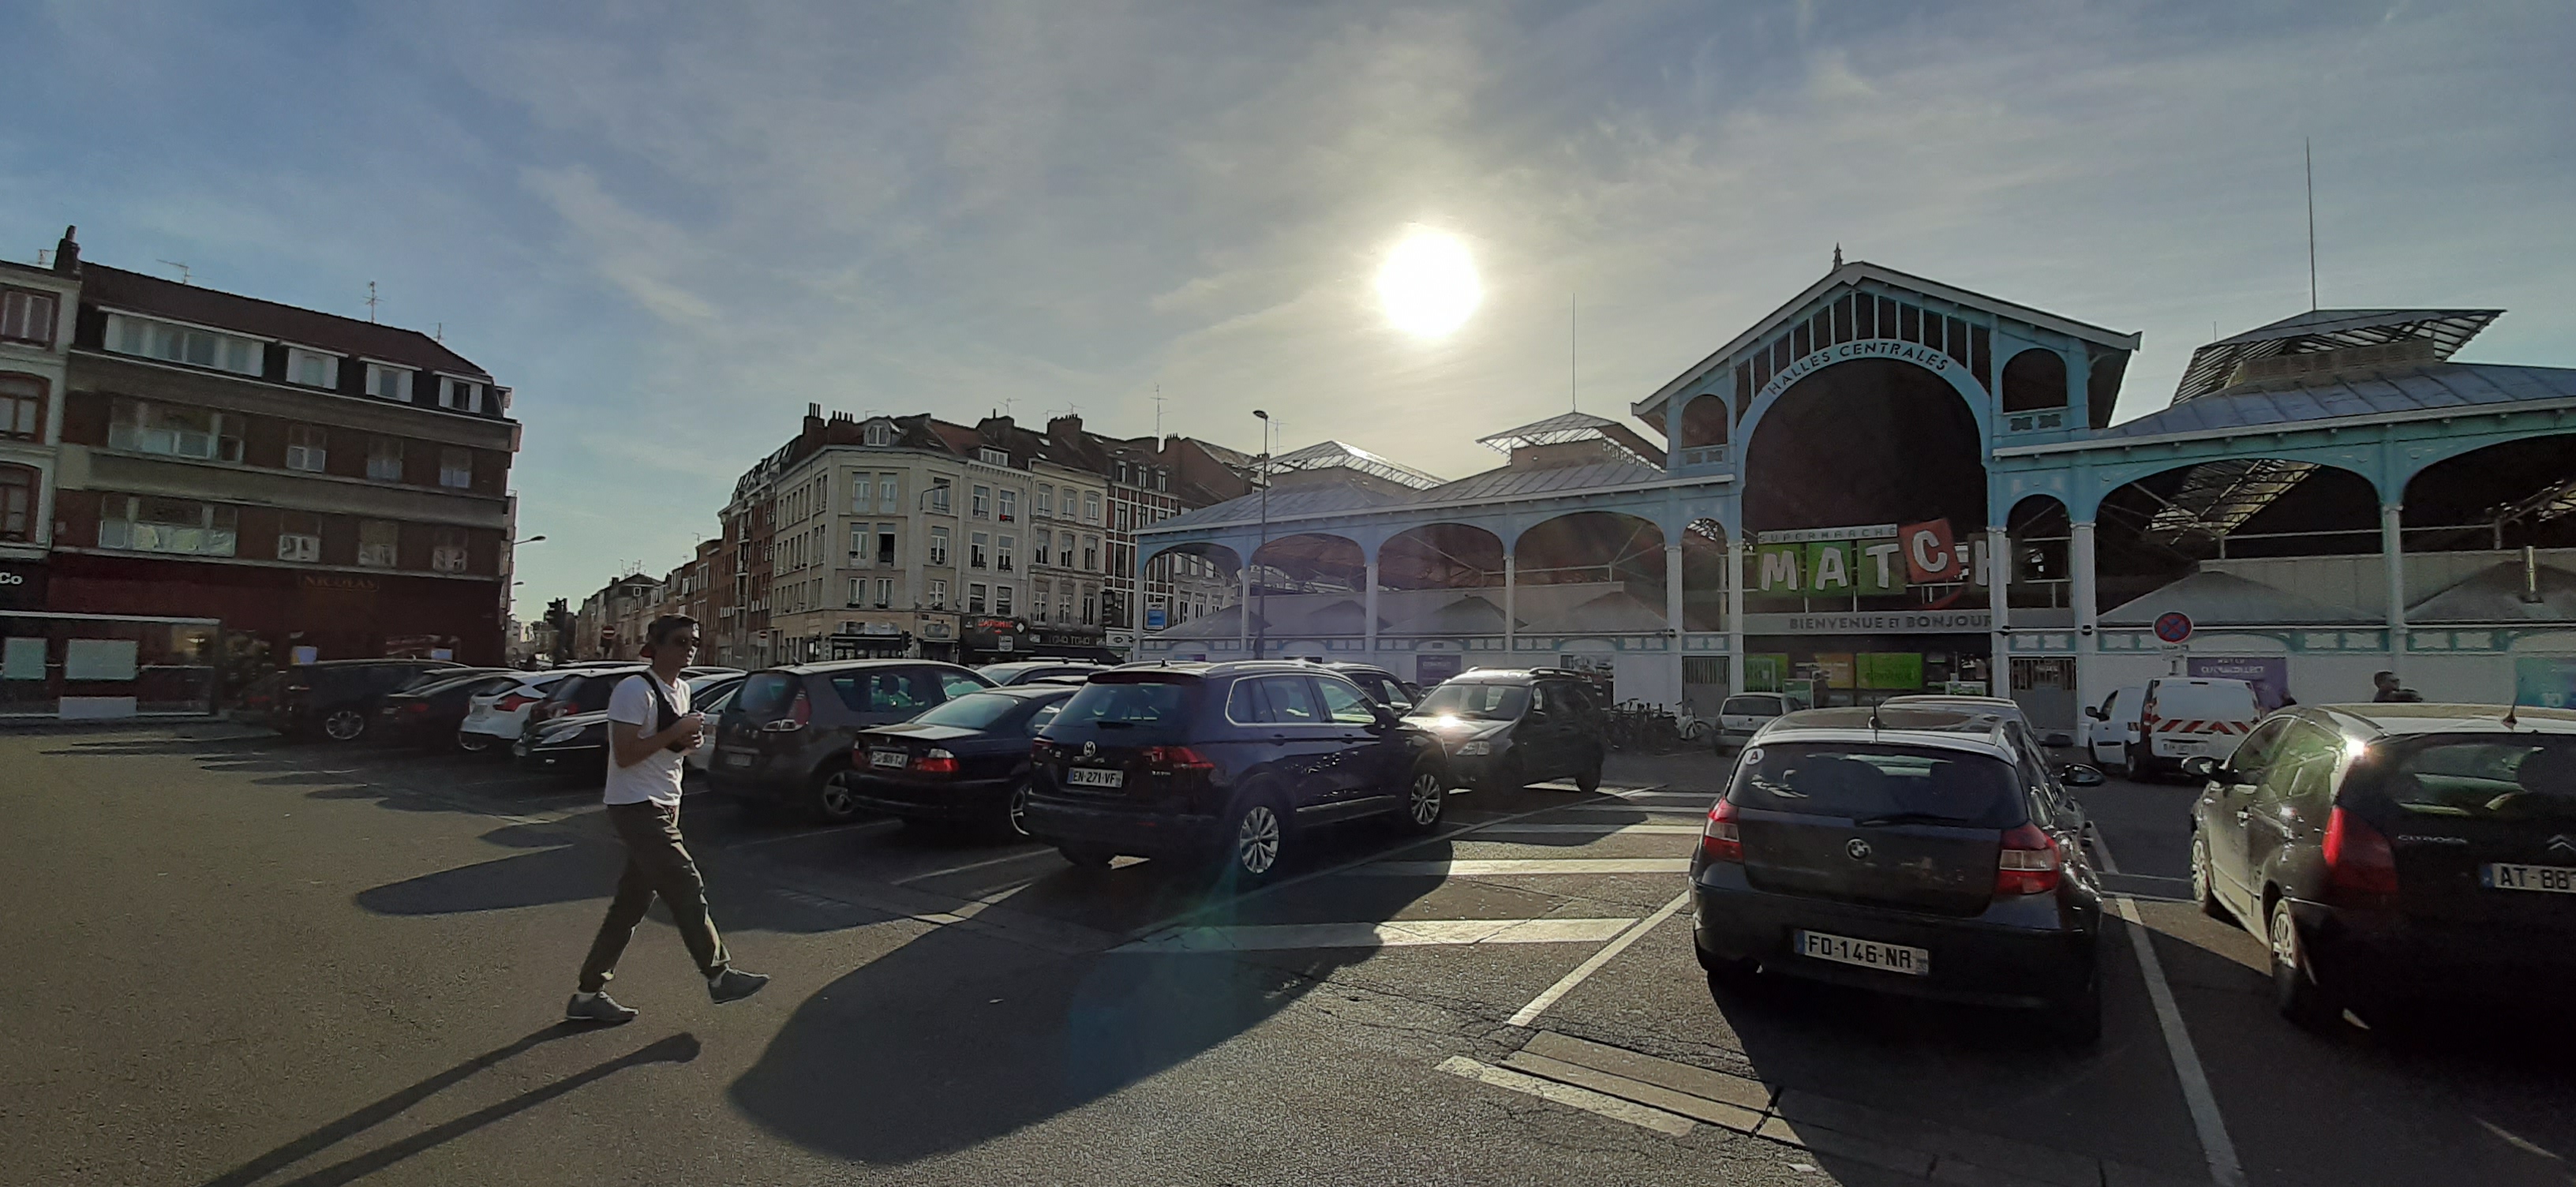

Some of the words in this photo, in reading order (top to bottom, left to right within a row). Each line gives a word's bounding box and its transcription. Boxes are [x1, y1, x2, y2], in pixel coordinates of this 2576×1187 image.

[1768, 352, 1831, 395] HALLES
[1840, 343, 1949, 371] CENTRALES
[1762, 530, 2012, 591] MATCH
[1789, 617, 1883, 629] BIENVENUE
[1889, 618, 1899, 628] ET
